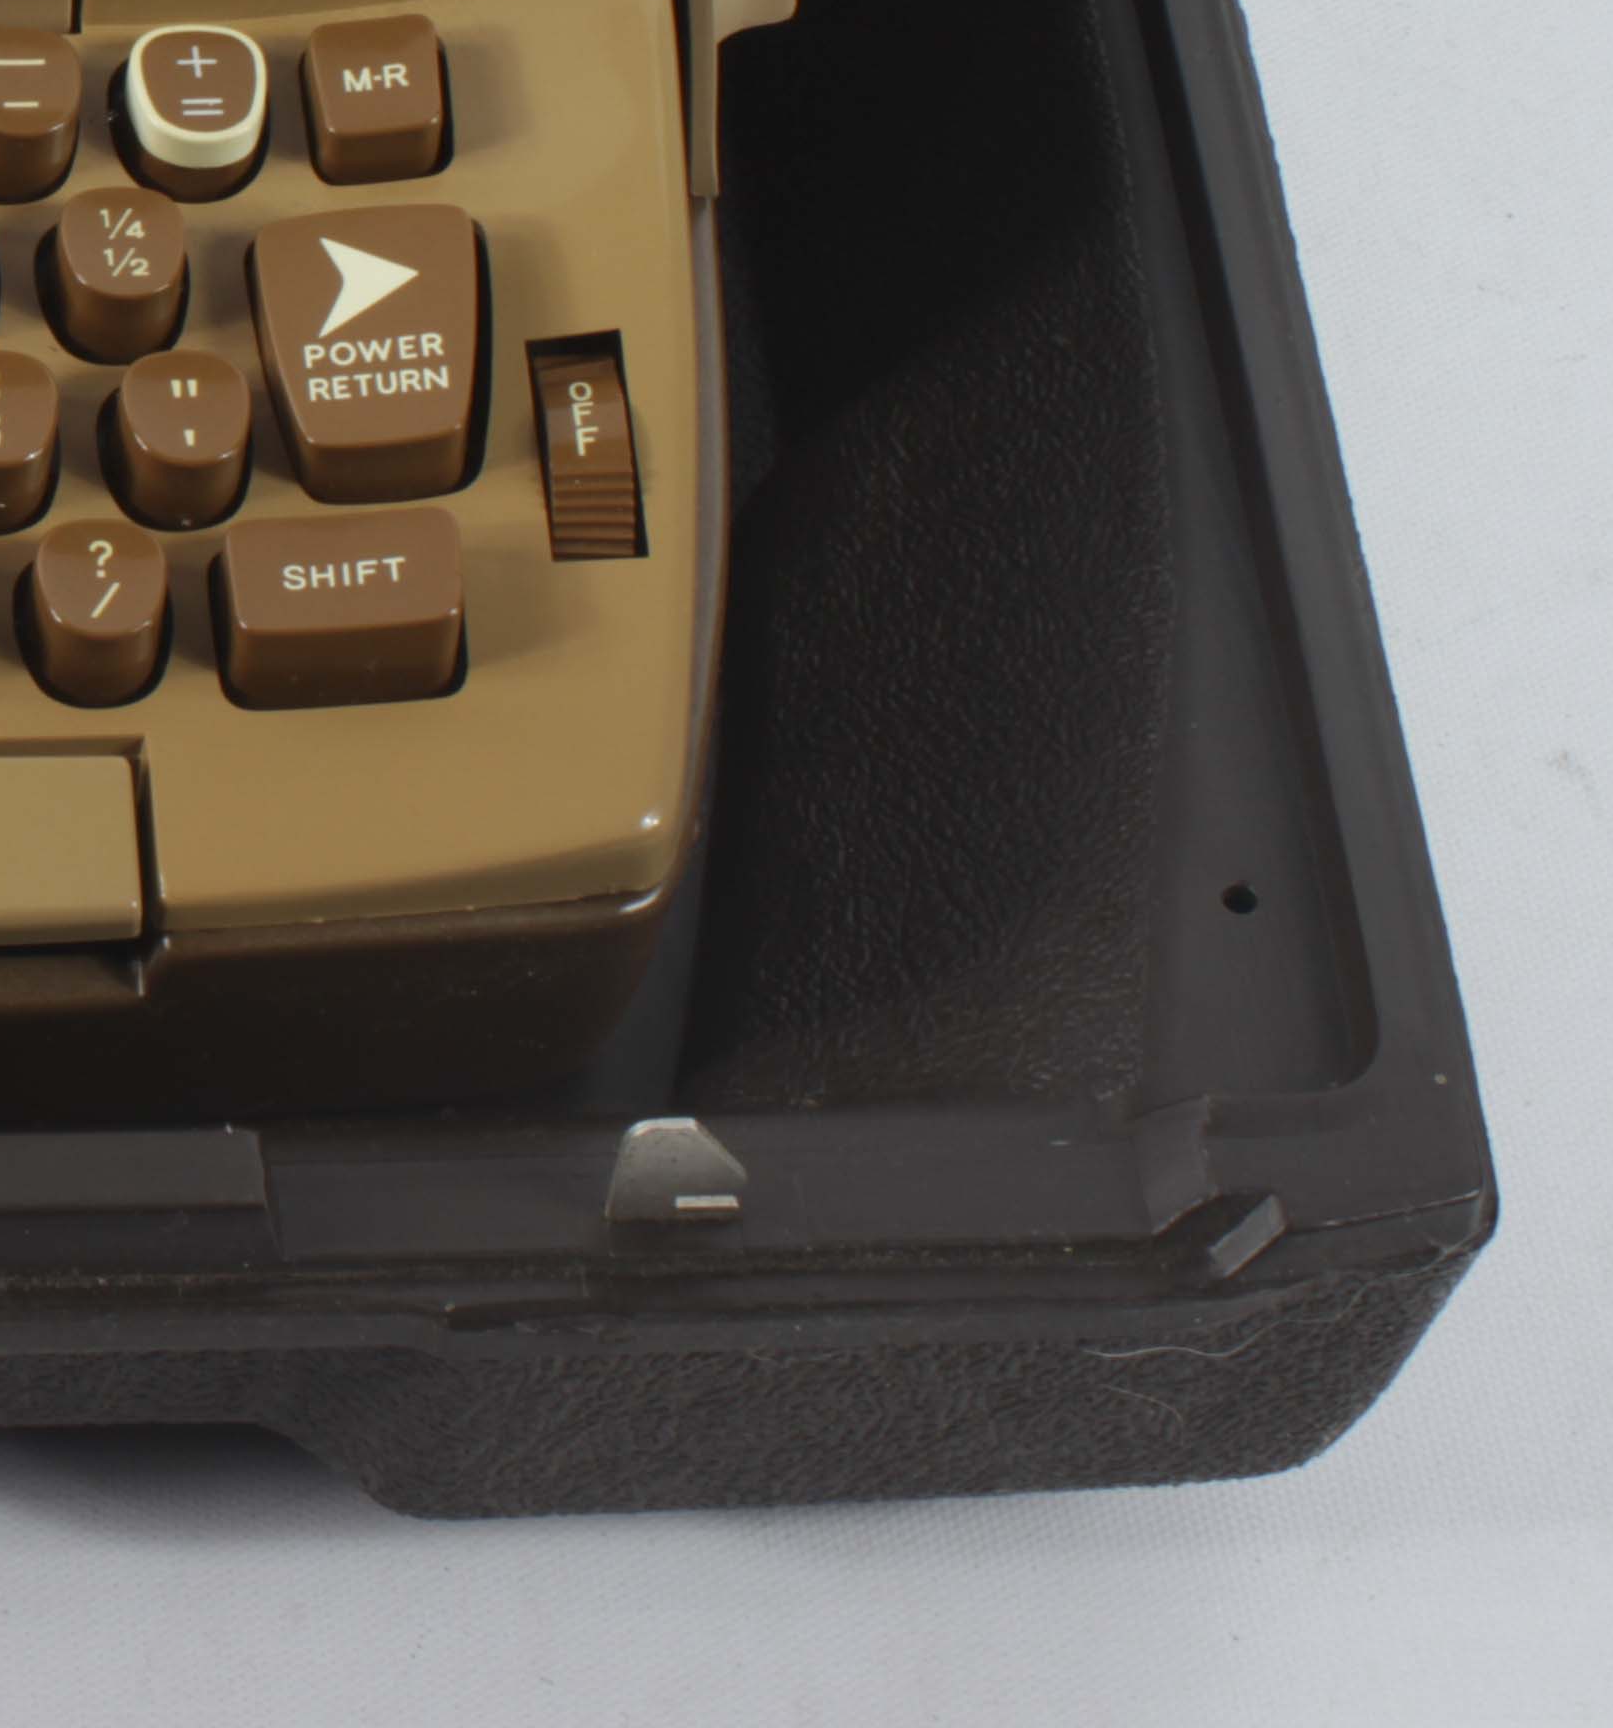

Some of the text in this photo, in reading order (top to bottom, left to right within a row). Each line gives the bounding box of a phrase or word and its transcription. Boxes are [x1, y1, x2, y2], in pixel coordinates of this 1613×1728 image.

[343, 64, 410, 92] M-R
[304, 333, 445, 369] POWER
[307, 367, 450, 401] RETURN
[568, 381, 599, 456] OFF
[89, 540, 113, 578] ?
[283, 556, 406, 590] SHIFT
